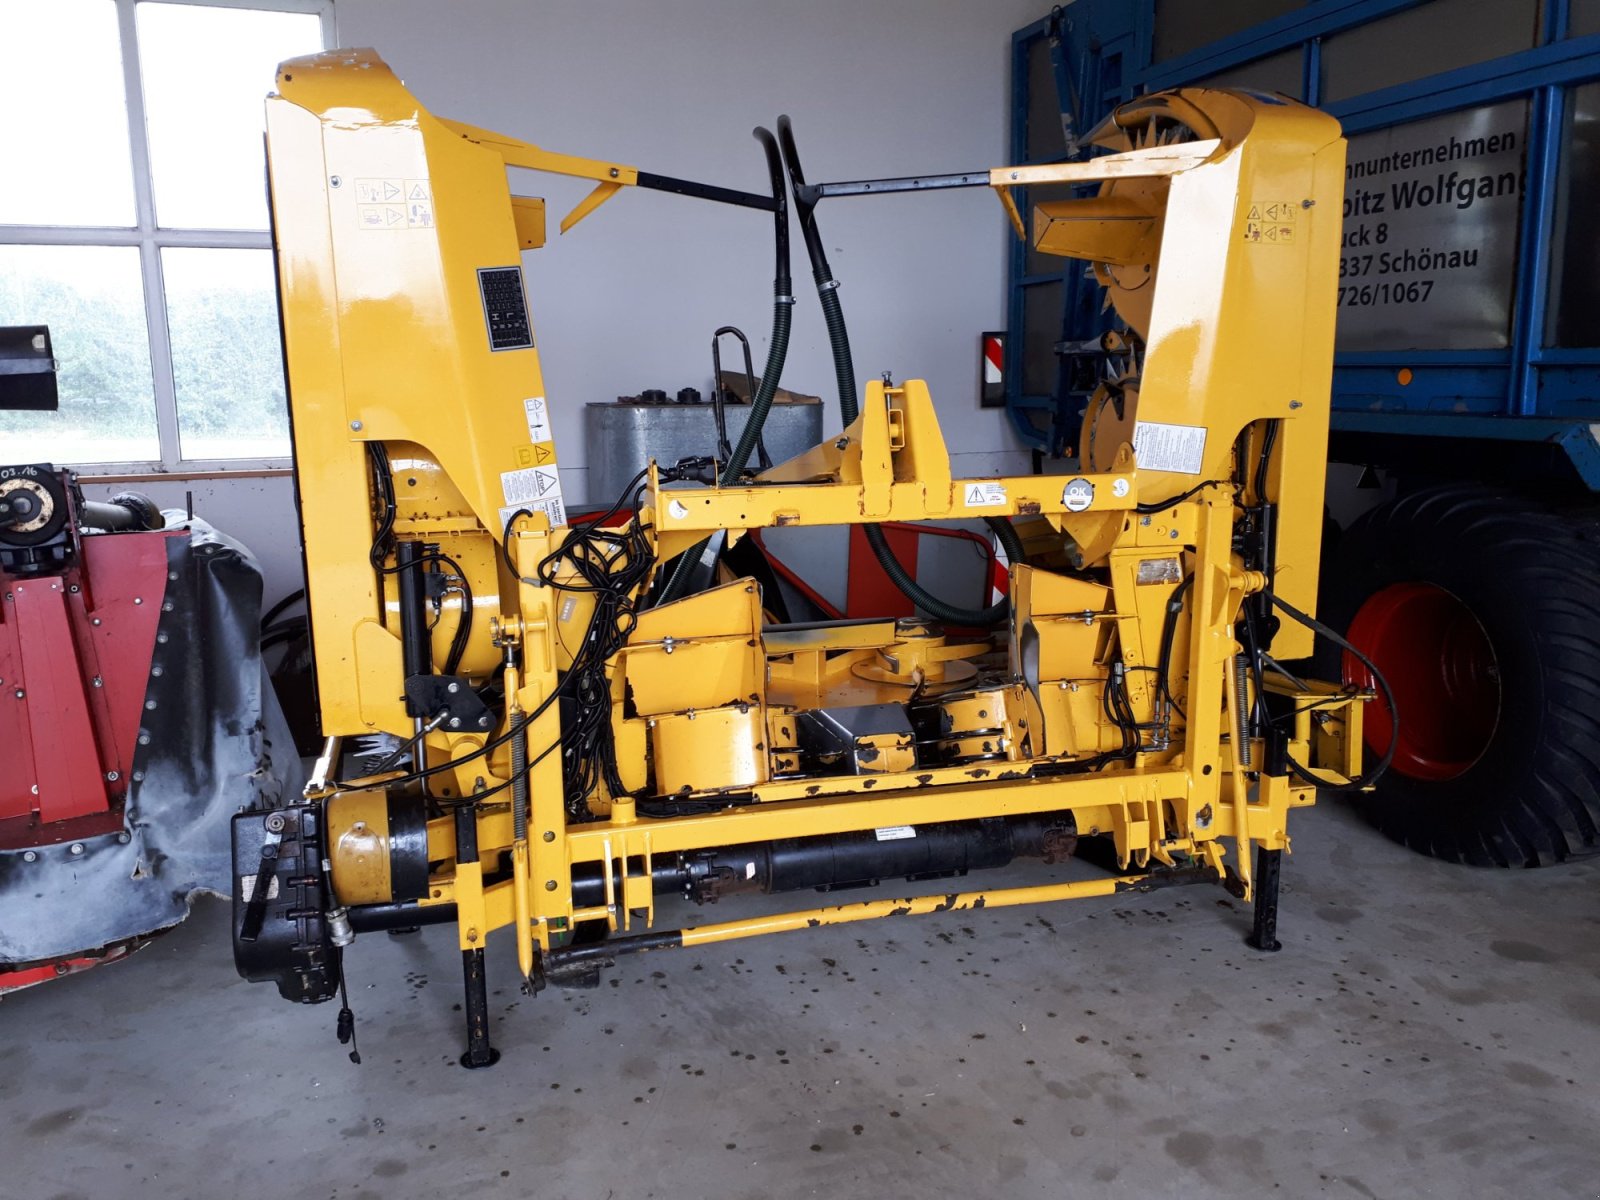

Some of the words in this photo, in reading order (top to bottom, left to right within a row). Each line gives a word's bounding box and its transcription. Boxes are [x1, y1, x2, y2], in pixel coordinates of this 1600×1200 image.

[1375, 222, 1388, 245] 8
[1378, 247, 1478, 274] Schönau
[1337, 281, 1434, 307] 726/1067
[1070, 486, 1087, 497] OK
